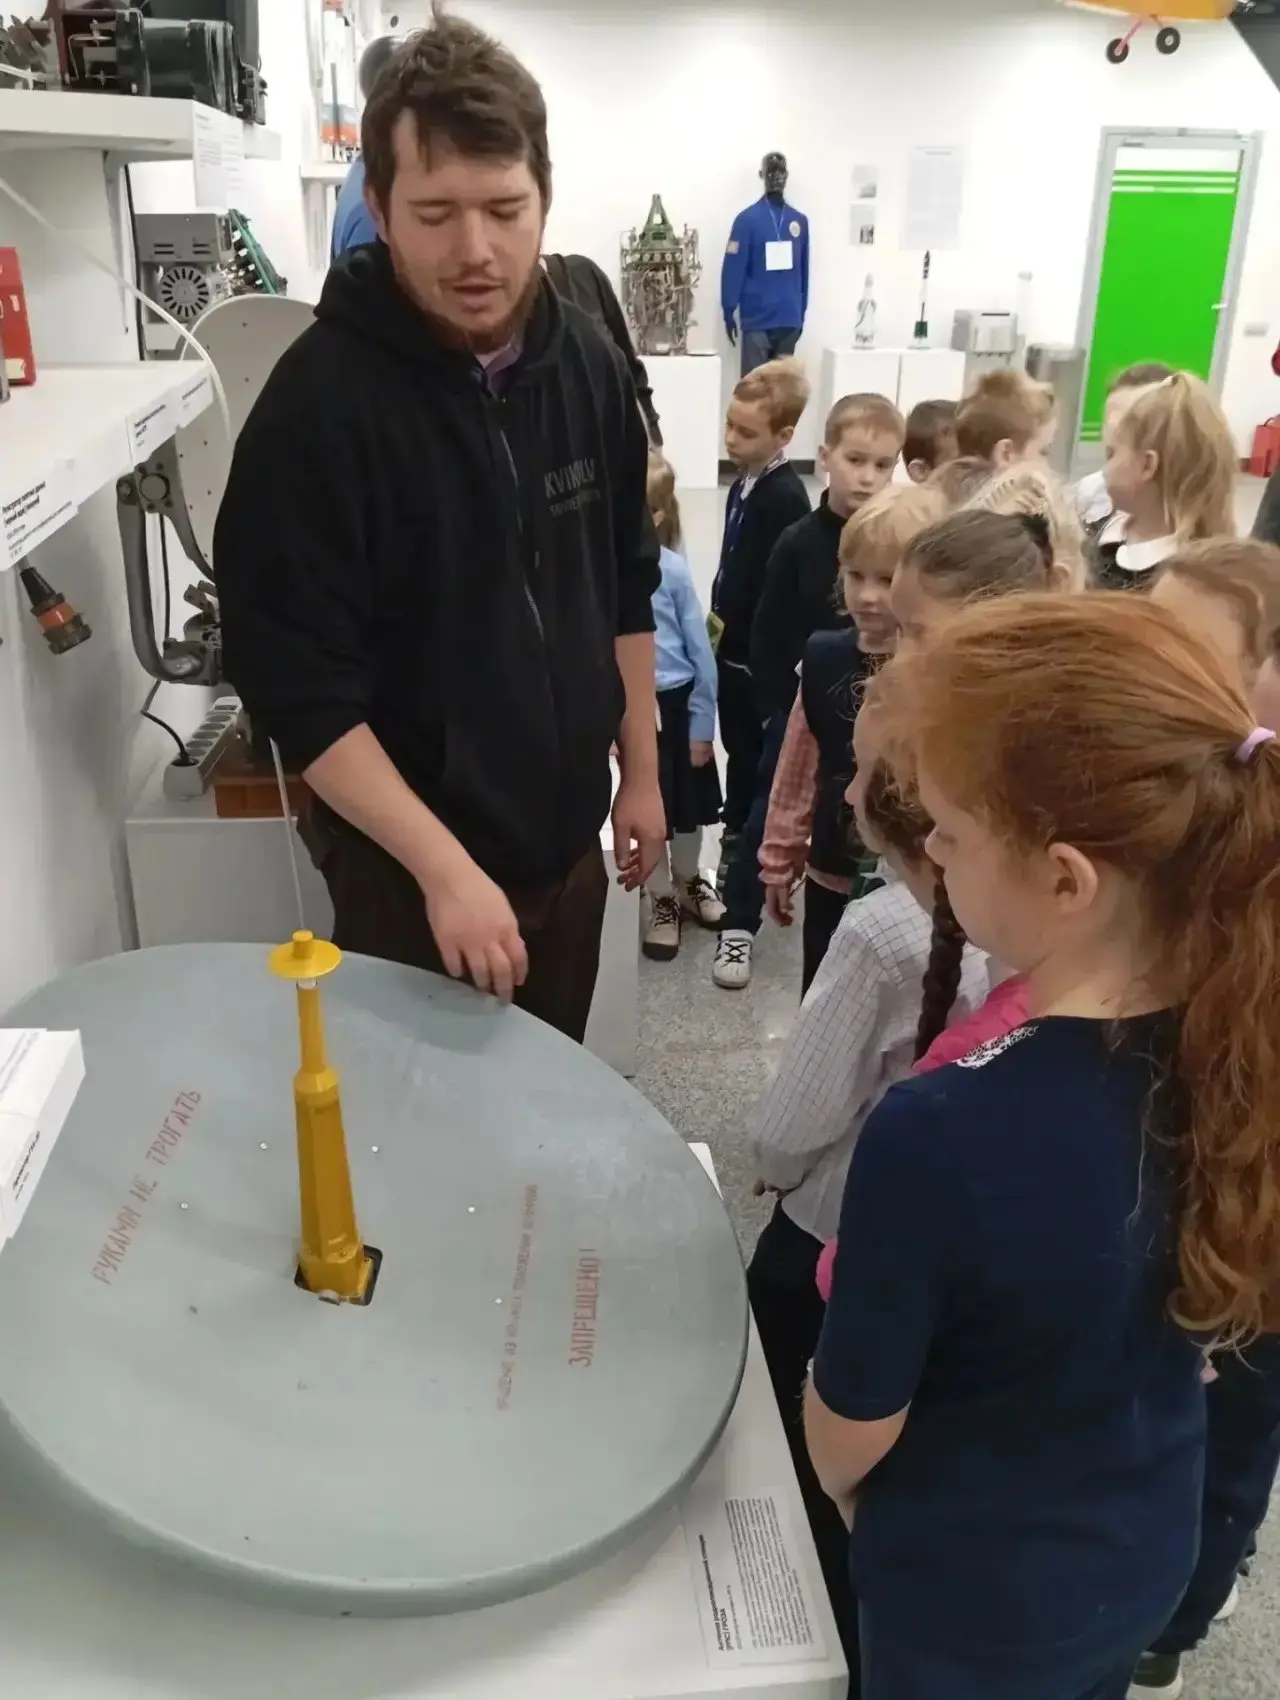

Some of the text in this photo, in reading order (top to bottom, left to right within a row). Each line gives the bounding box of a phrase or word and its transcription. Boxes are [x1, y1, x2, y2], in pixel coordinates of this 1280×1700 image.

[91, 1091, 202, 1285] РУКАМИ НЕ ТРОГАТЬ
